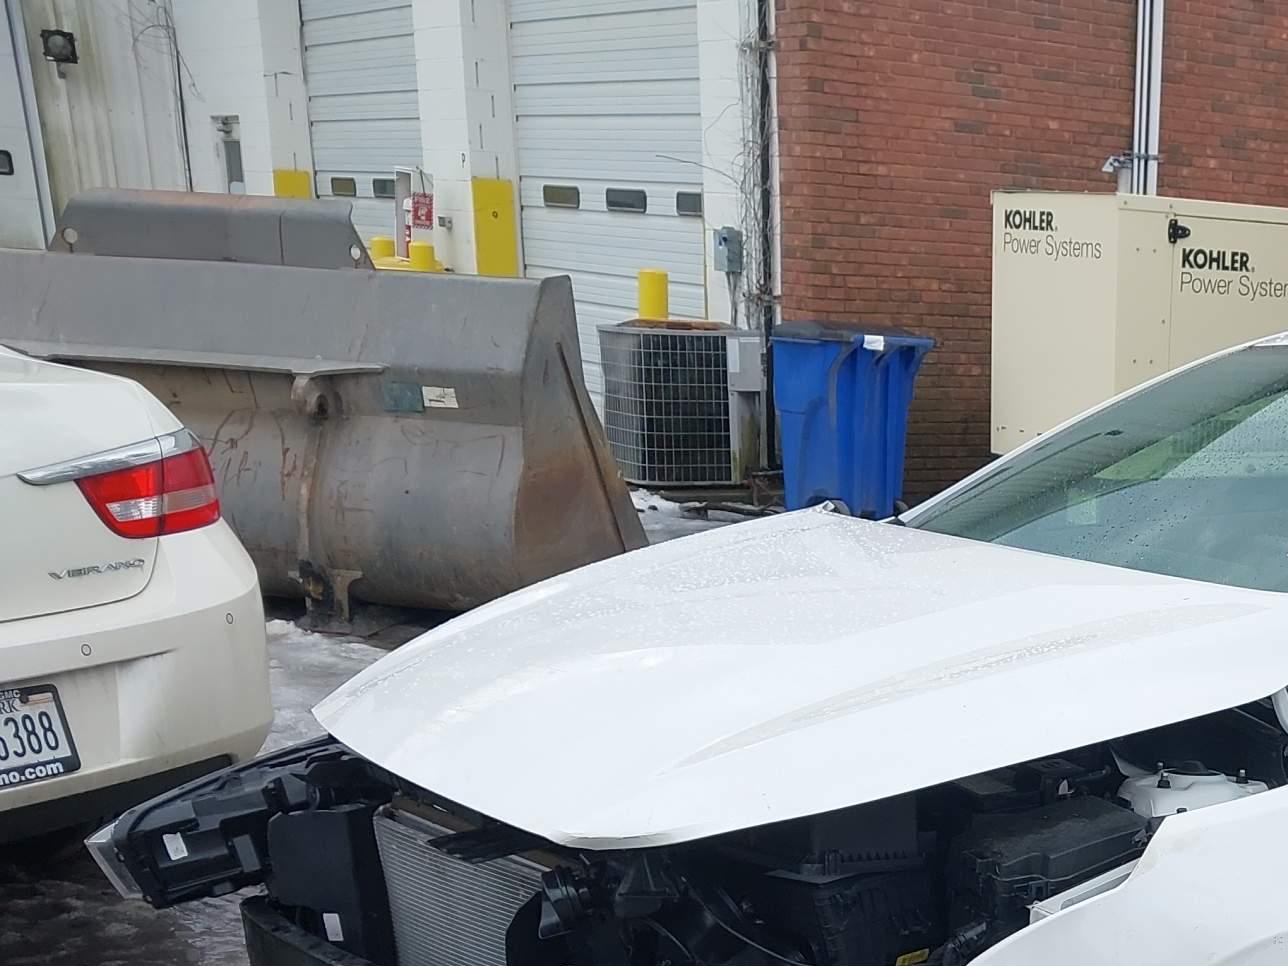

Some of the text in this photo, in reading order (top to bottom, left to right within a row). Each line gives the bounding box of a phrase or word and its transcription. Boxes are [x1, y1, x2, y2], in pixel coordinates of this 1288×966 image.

[1003, 232, 1102, 261] Power Systems
[1180, 271, 1233, 295] Power
